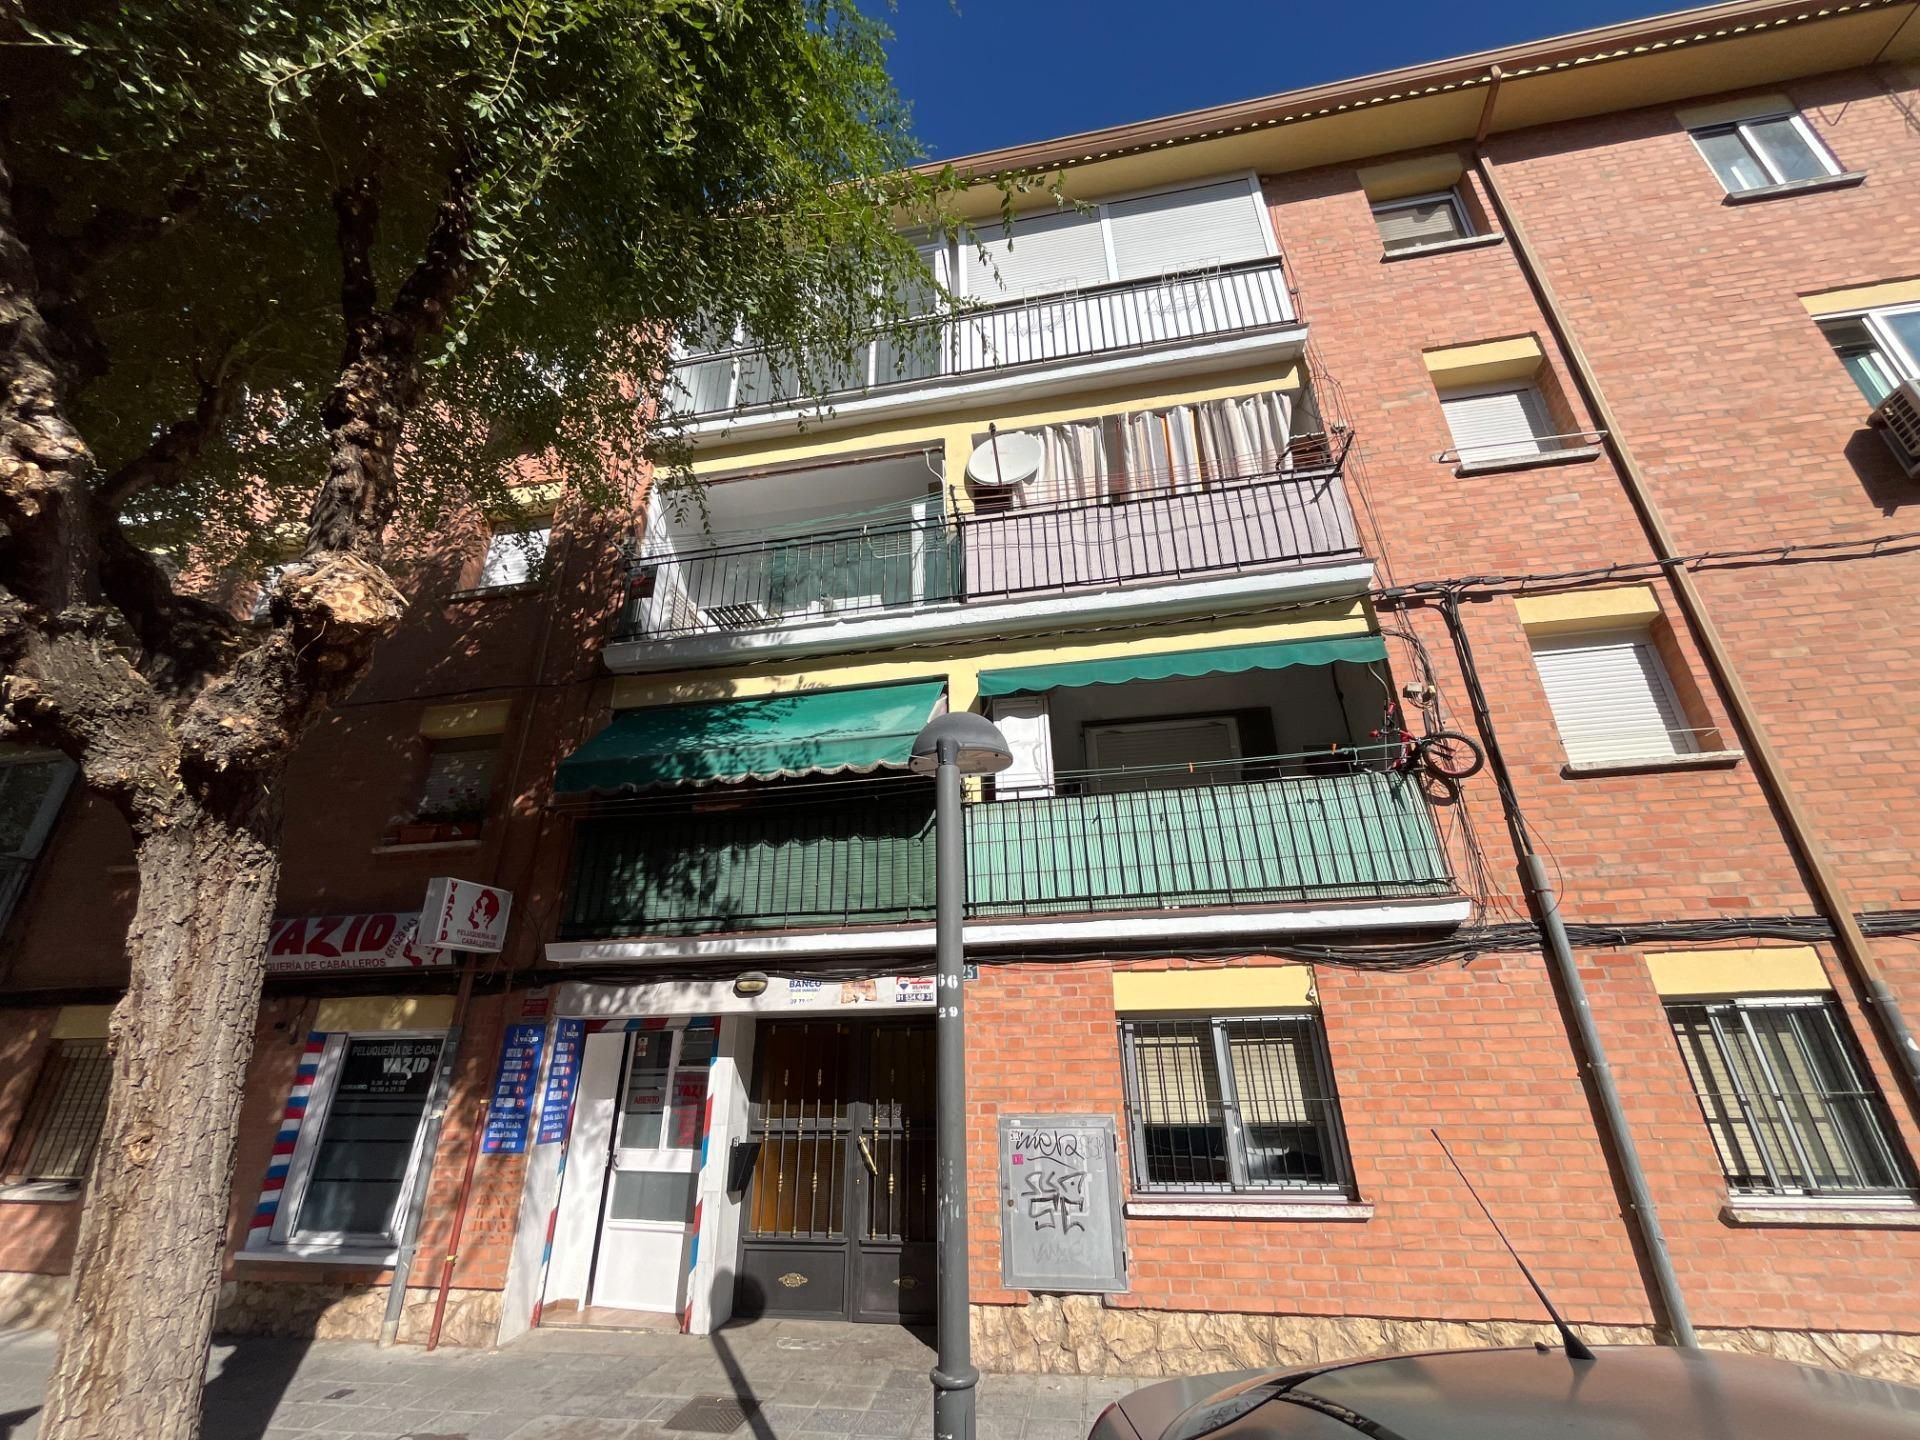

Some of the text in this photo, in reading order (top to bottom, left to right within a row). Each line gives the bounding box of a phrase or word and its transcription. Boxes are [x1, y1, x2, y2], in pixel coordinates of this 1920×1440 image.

[304, 961, 317, 970] DE
[320, 958, 386, 969] CABALLEROS
[939, 1006, 958, 1018] 29
